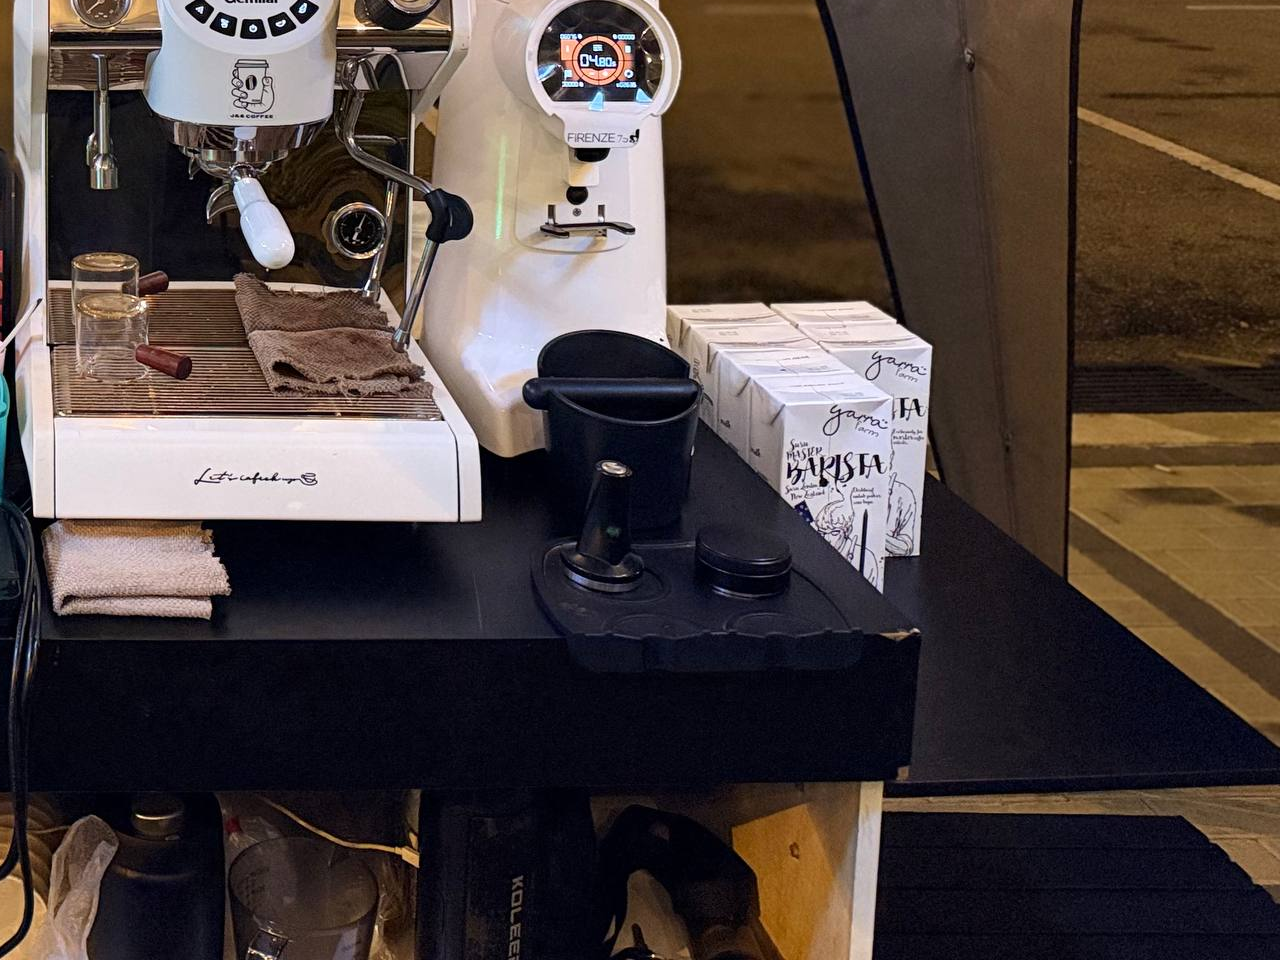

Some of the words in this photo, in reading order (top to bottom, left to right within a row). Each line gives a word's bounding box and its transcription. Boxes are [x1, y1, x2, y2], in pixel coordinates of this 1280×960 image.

[567, 132, 616, 143] FIRENZE
[864, 350, 928, 381] yarra
[822, 404, 889, 436] yarra
[786, 451, 888, 487] BARISTA
[507, 874, 524, 960] KOLEE
